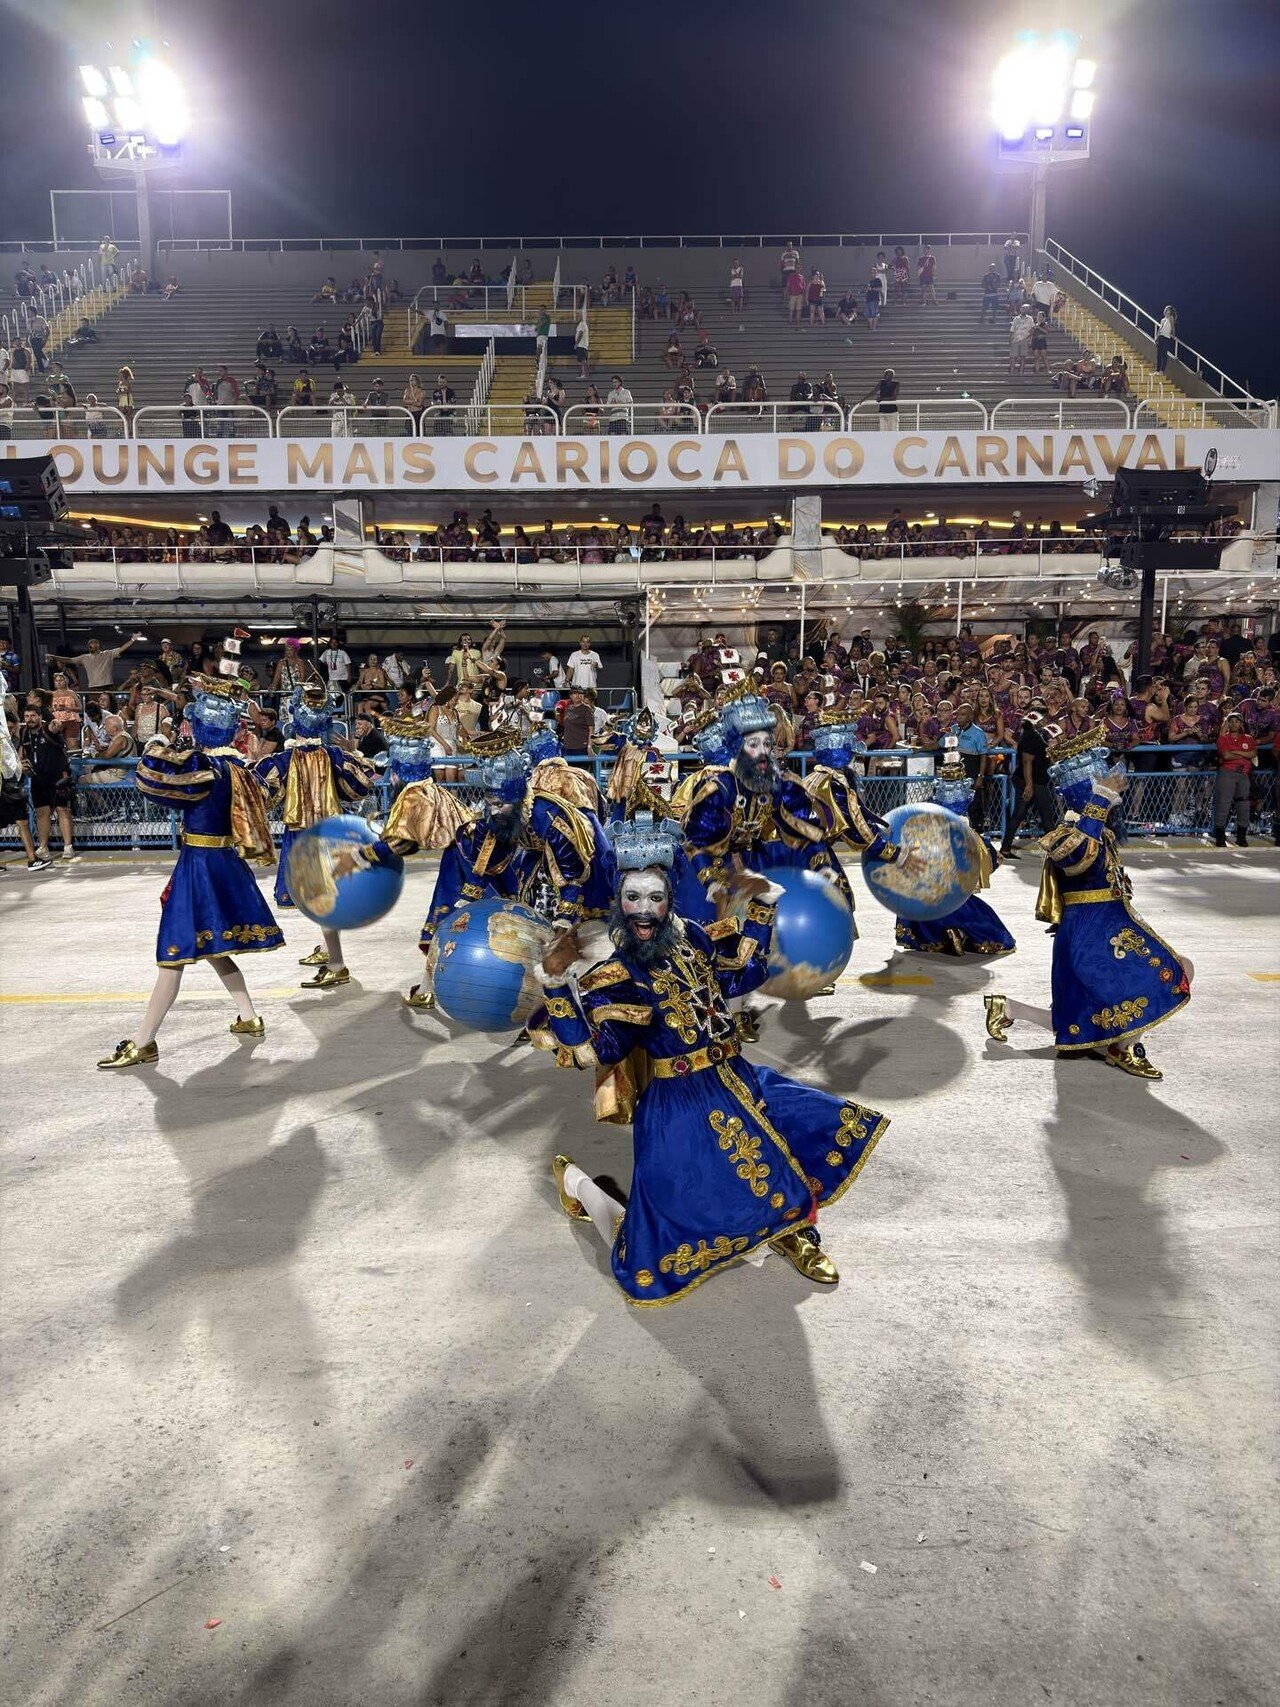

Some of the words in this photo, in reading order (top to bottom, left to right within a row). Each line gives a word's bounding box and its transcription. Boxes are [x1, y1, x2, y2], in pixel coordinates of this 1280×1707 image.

[287, 441, 436, 484] MAIS
[464, 439, 750, 483] CARIOCA
[778, 437, 865, 480] DO
[893, 434, 1202, 478] CARNAVAL
